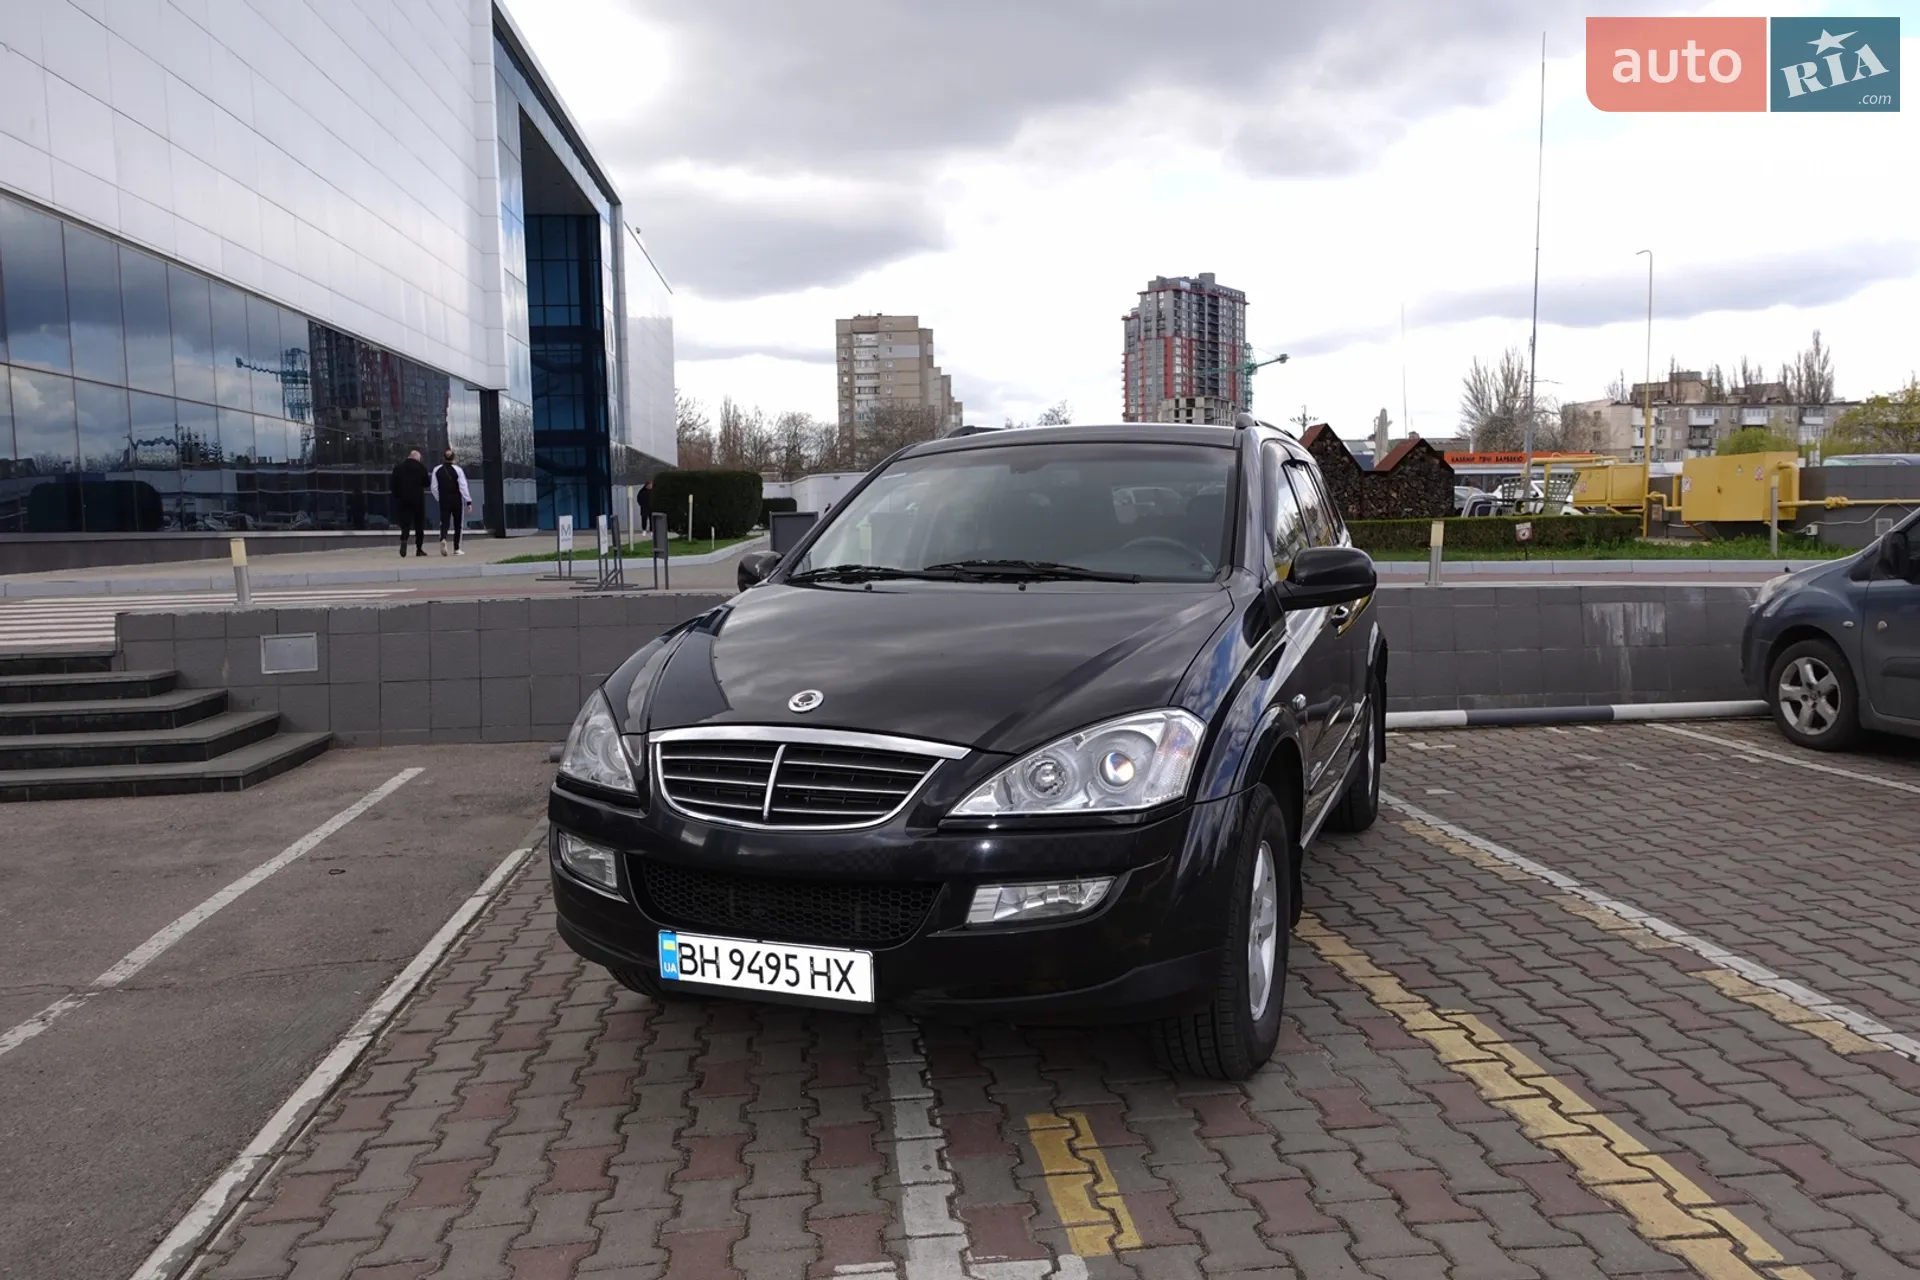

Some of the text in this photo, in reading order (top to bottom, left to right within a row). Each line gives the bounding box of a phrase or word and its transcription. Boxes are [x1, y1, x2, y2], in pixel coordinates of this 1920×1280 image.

[663, 961, 677, 973] UA
[678, 942, 856, 994] BH 9495 HX
